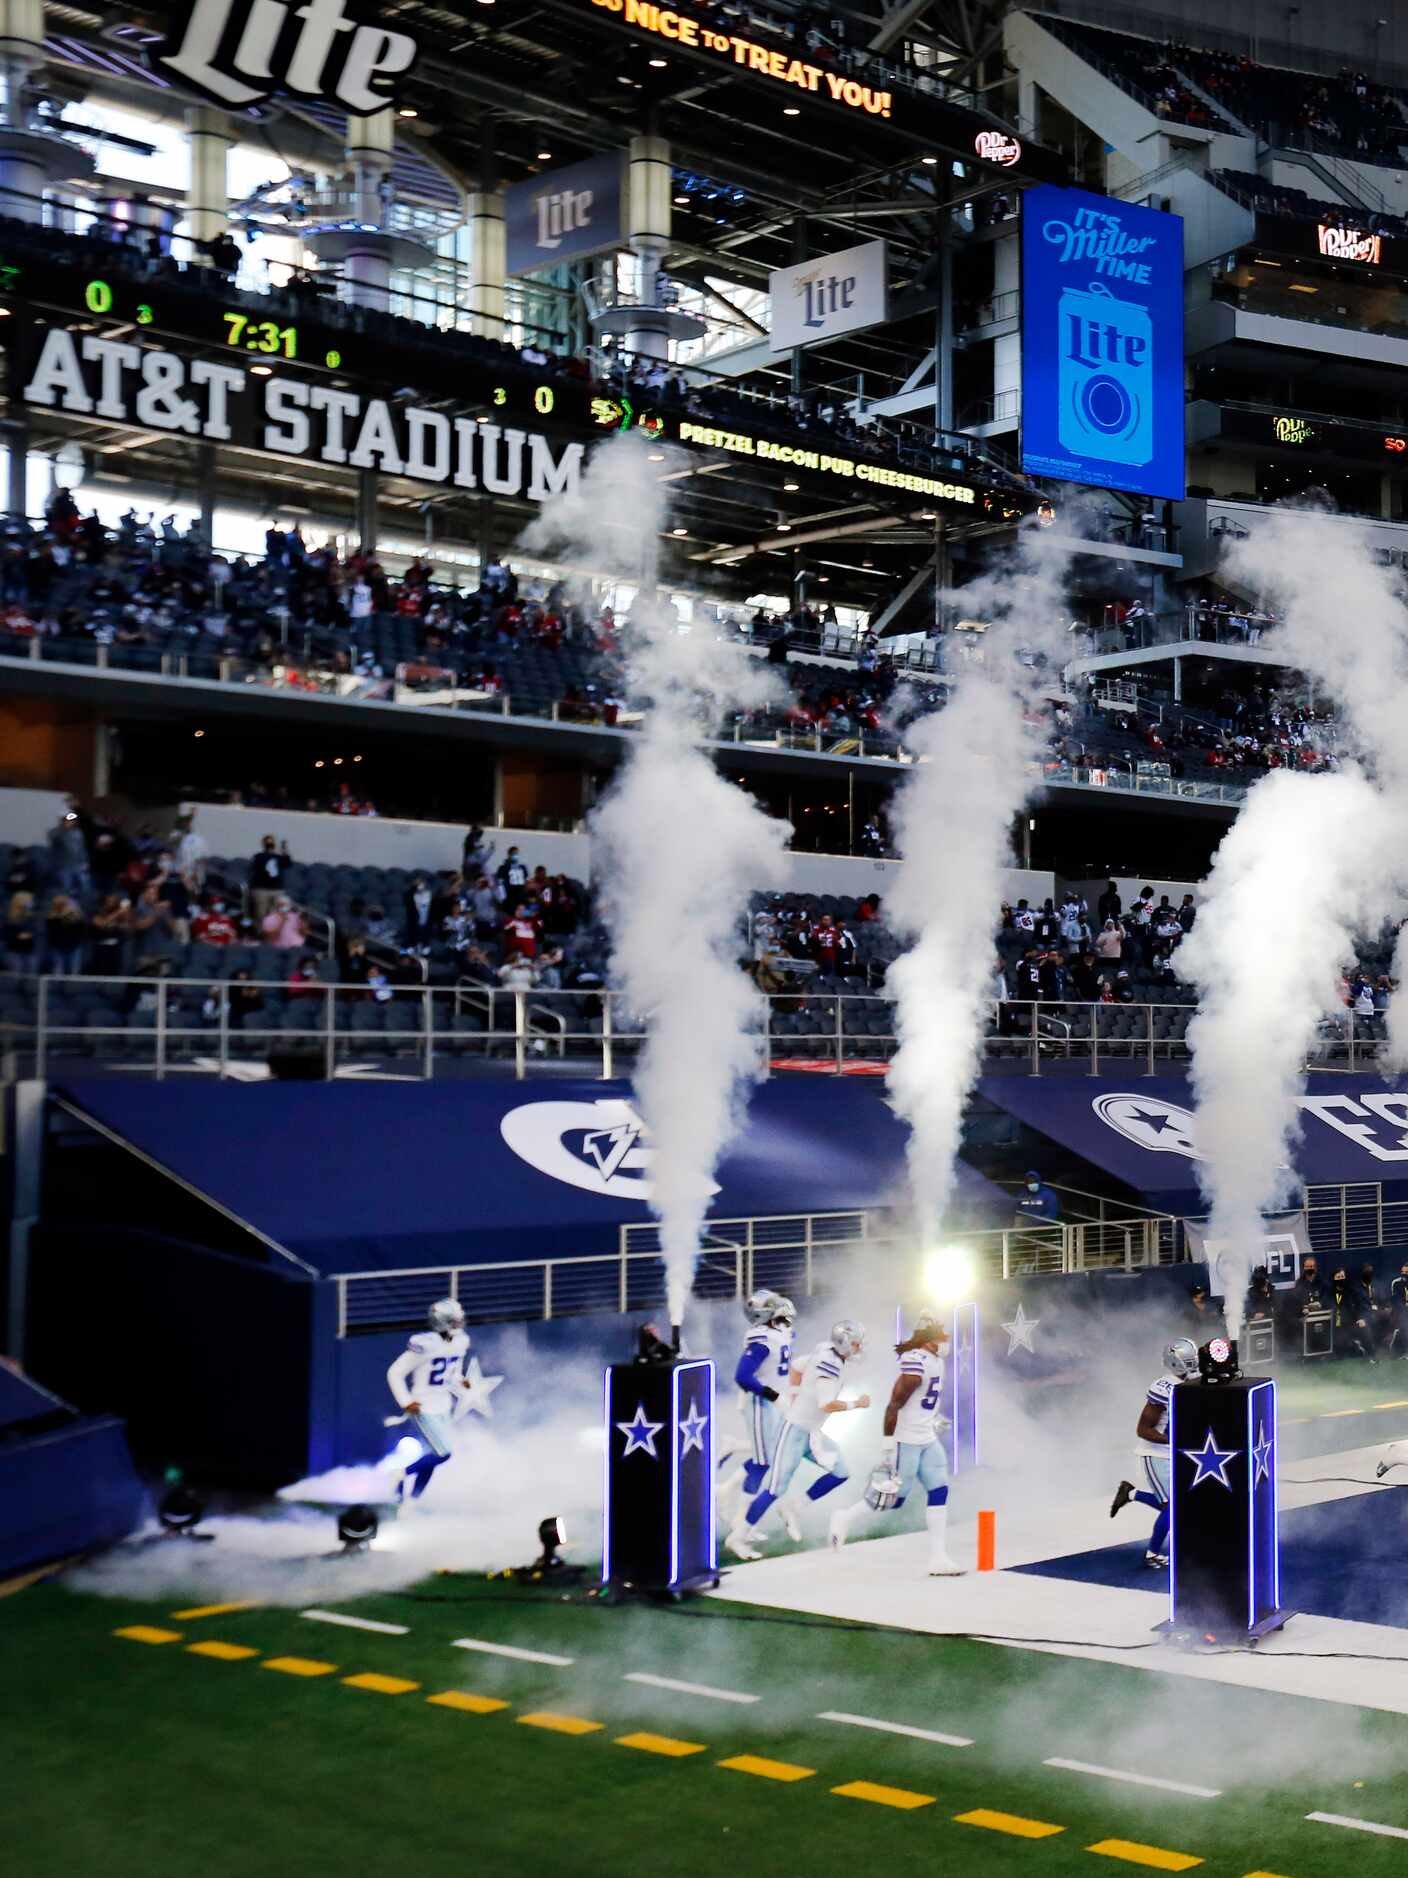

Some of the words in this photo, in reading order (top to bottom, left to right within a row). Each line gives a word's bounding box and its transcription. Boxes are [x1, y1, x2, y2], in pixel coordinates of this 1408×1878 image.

[159, 0, 418, 111] Lite
[624, 0, 699, 47] NICE
[700, 29, 730, 52] TO
[729, 36, 824, 91] TREAT
[825, 72, 892, 118] YOU!
[535, 189, 594, 249] Lite
[1042, 220, 1157, 263] Miller
[1073, 207, 1122, 234] IT'S
[1096, 255, 1153, 285] TIME
[802, 275, 857, 328] Lite
[85, 280, 113, 313] 0
[223, 312, 297, 359] 7:31
[493, 387, 507, 405] 3
[534, 386, 554, 414] 0
[1066, 313, 1147, 370] Lite
[24, 328, 246, 440] AT&T
[264, 377, 586, 501] STADIUM
[680, 422, 756, 455] PRETZEL
[756, 441, 819, 470] BACON
[820, 454, 855, 478] PUB
[855, 462, 975, 504] CHEESEBURGER
[1385, 437, 1406, 451] SO
